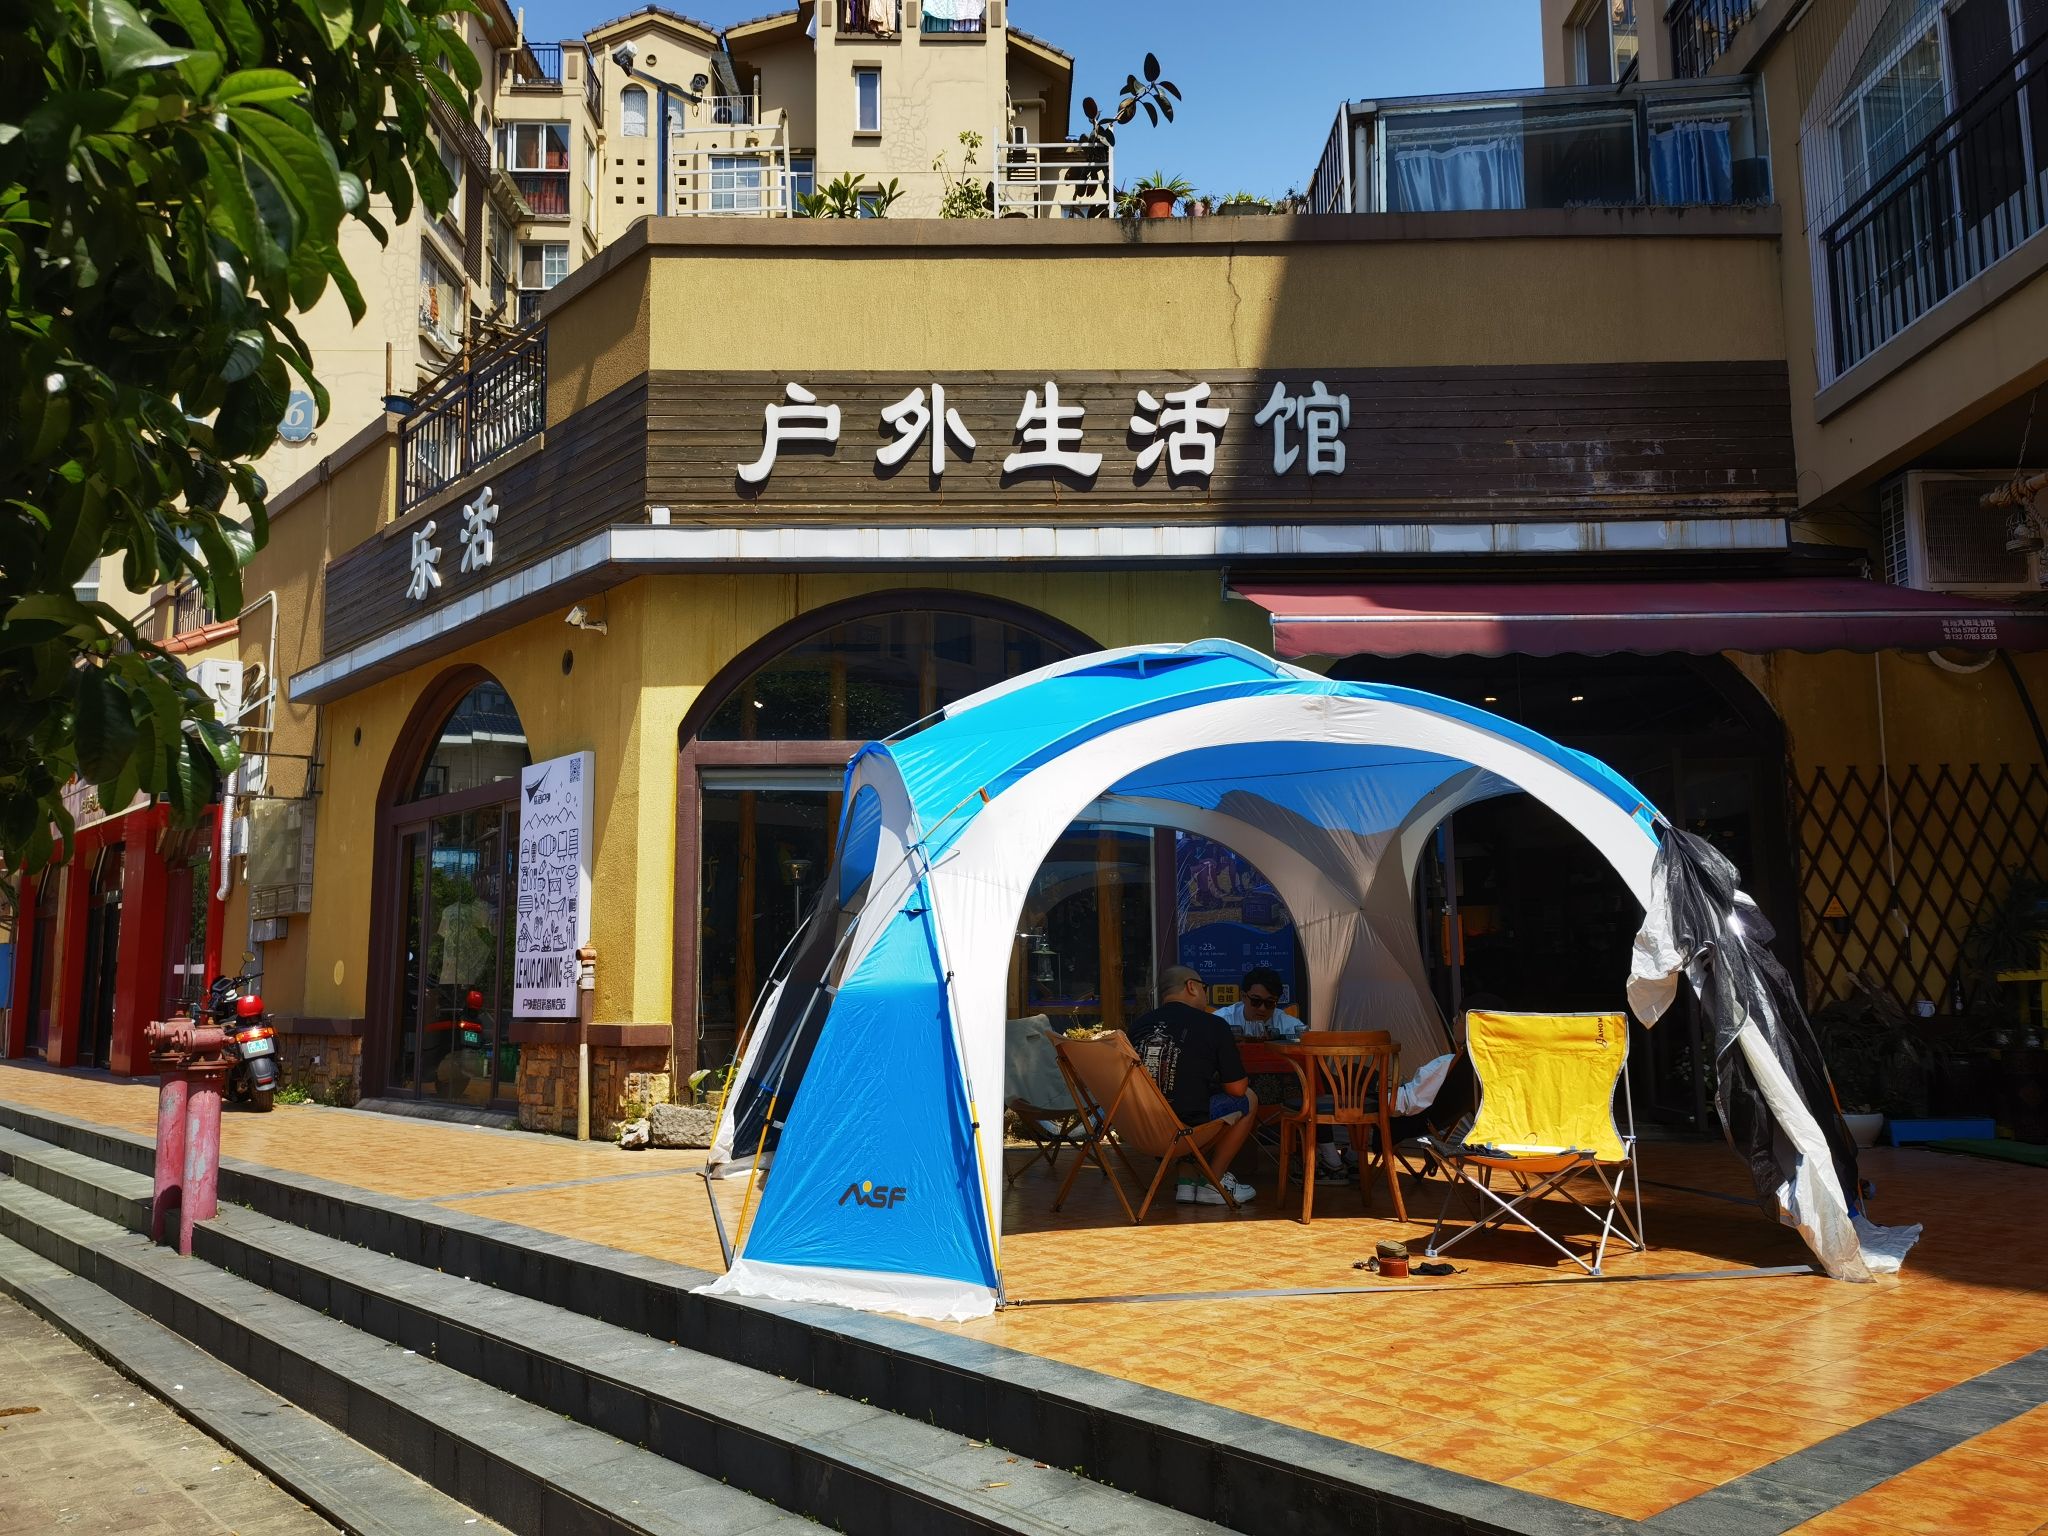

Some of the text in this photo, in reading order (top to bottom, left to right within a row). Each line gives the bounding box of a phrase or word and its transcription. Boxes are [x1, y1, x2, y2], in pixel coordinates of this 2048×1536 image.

[285, 400, 307, 426] 6
[738, 381, 1350, 482] 户外生活馆
[406, 486, 499, 600] 乐活
[537, 956, 562, 988] CAMPING
